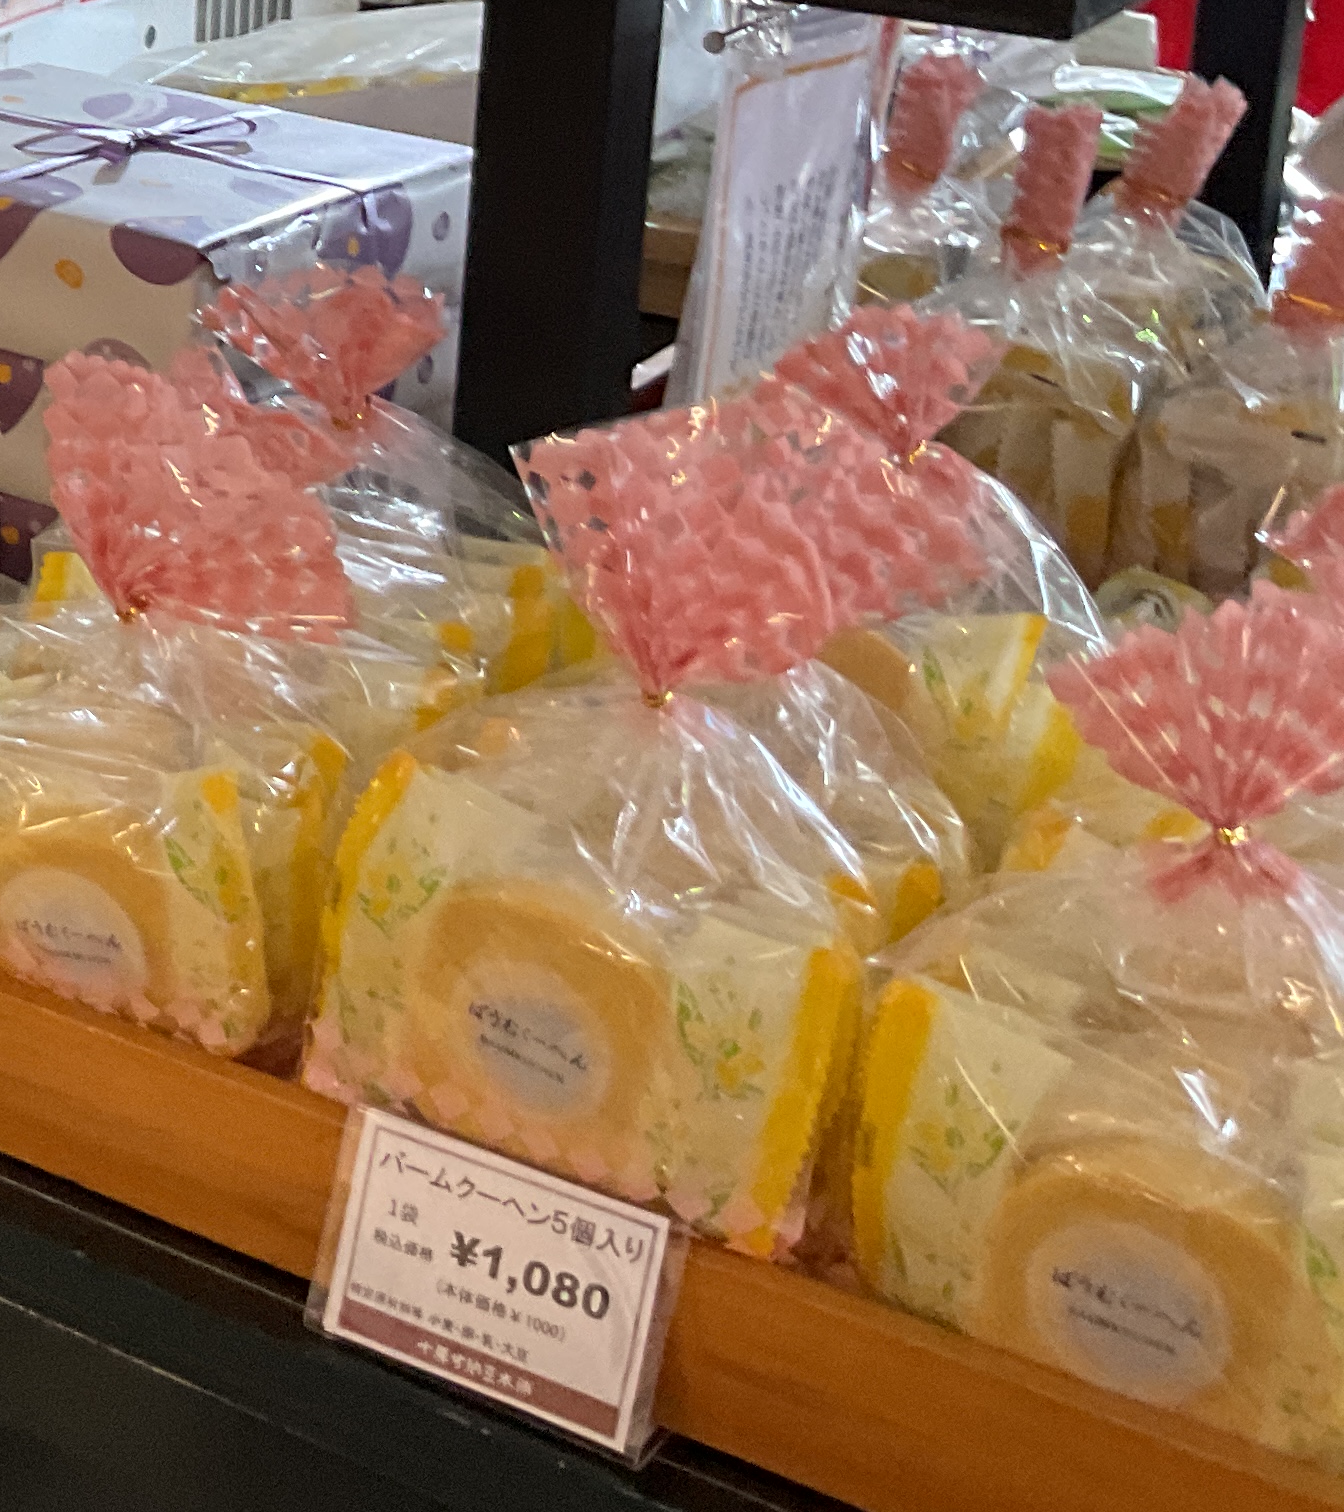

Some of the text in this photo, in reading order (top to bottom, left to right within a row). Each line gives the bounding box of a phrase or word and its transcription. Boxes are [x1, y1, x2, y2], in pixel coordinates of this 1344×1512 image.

[379, 1151, 644, 1264] バームクーヘン5個入り
[387, 1198, 419, 1225] 1袋
[450, 1230, 610, 1320] ¥1,080
